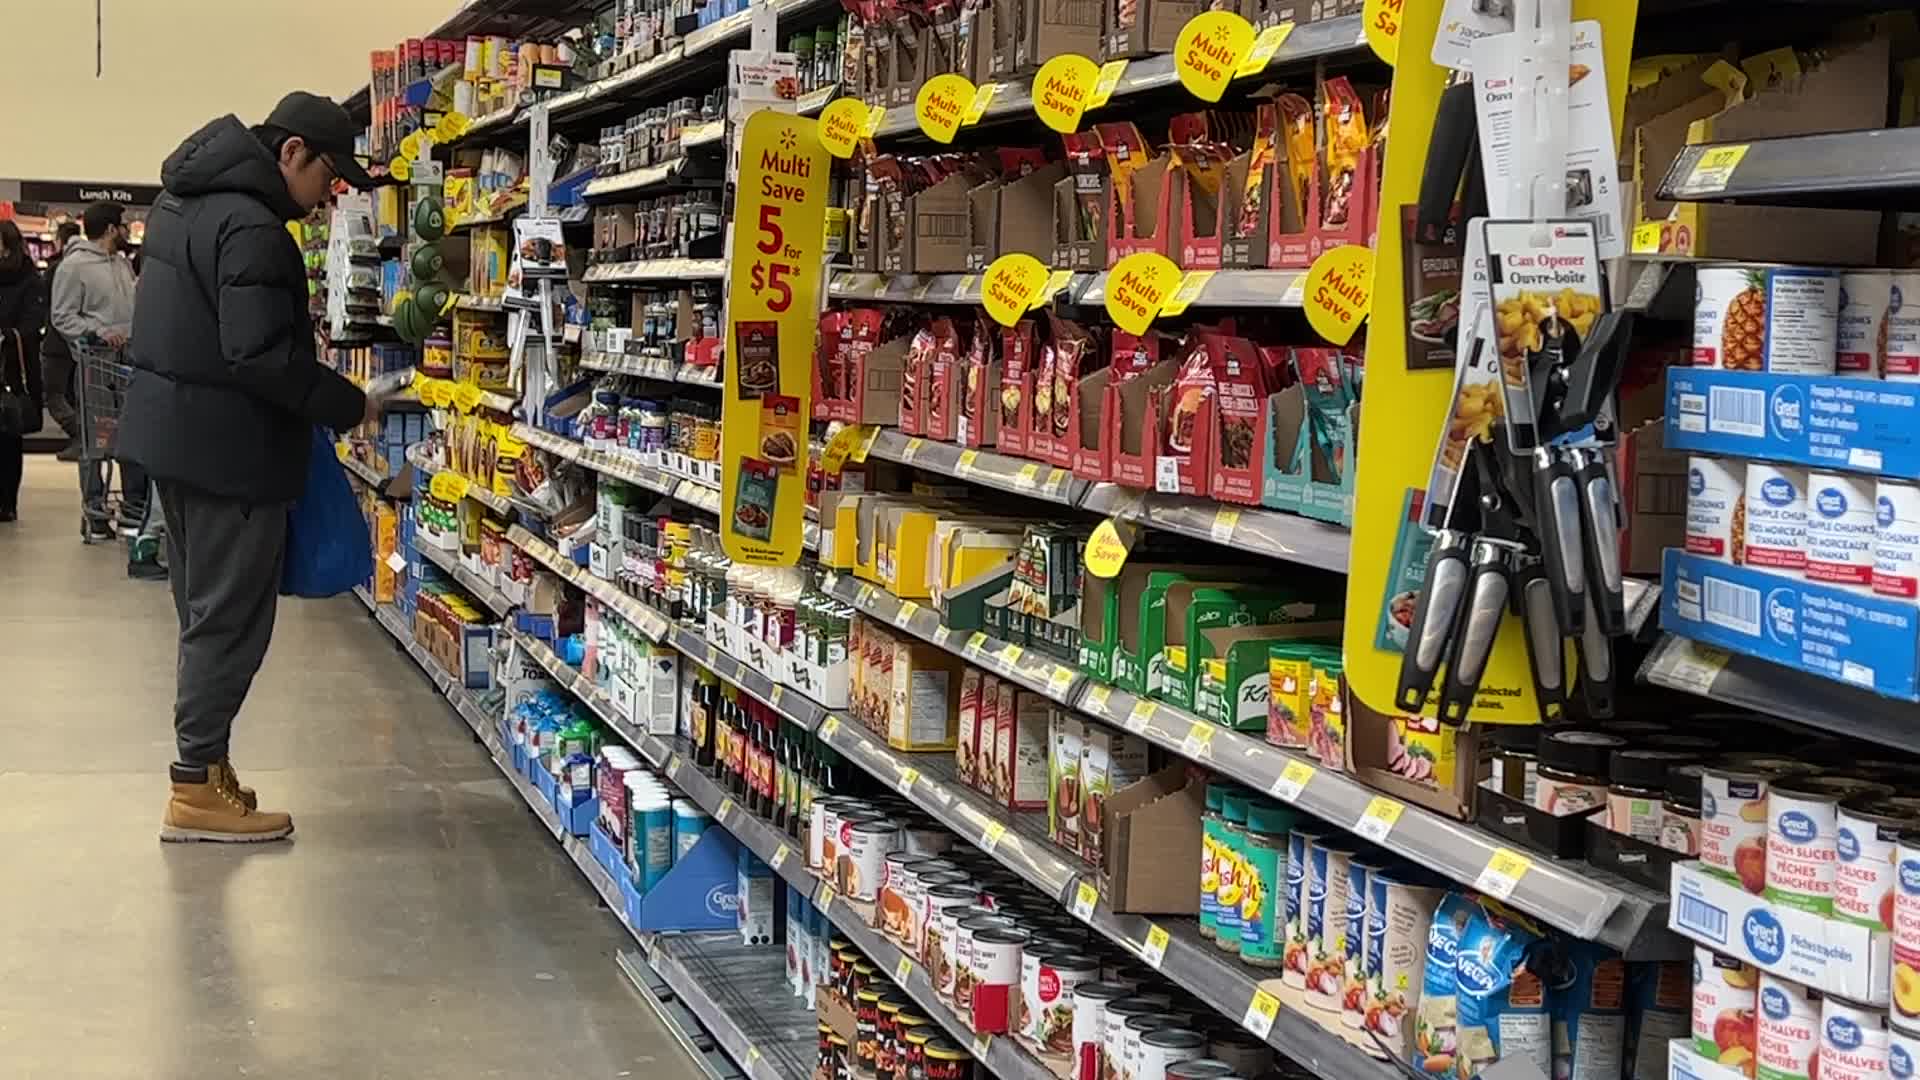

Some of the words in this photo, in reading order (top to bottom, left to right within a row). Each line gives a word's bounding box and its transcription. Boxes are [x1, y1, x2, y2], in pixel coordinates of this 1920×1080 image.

[1374, 11, 1397, 36] Sa
[1191, 32, 1236, 65] Multi
[1184, 51, 1222, 81] Save
[1046, 77, 1083, 102] Multi
[928, 93, 960, 115] Multi
[1042, 94, 1075, 117] Save
[827, 114, 858, 135] Multi
[922, 106, 952, 129] Save
[824, 127, 851, 146] Save
[760, 149, 810, 177] Multi
[80, 188, 110, 200] Lunch
[112, 190, 132, 201] Kits
[762, 176, 805, 202] Save
[756, 204, 783, 255] 5
[784, 244, 802, 260] for
[1508, 254, 1534, 267] Can
[1537, 254, 1585, 269] Opener
[995, 270, 1028, 298] Multi
[1120, 271, 1162, 304] Multi
[1322, 267, 1368, 308] Multi
[1510, 270, 1586, 284] Ouvre-boîte
[988, 284, 1017, 310] Save
[1114, 288, 1147, 317] Save
[1313, 287, 1351, 323] Save
[1797, 847, 1837, 861] SLICES
[1844, 866, 1876, 882] SLICES
[1429, 928, 1457, 956] VEG
[1747, 916, 1778, 944] Great
[1770, 1024, 1810, 1041] HALVES
[1841, 1053, 1885, 1072] HALVES
